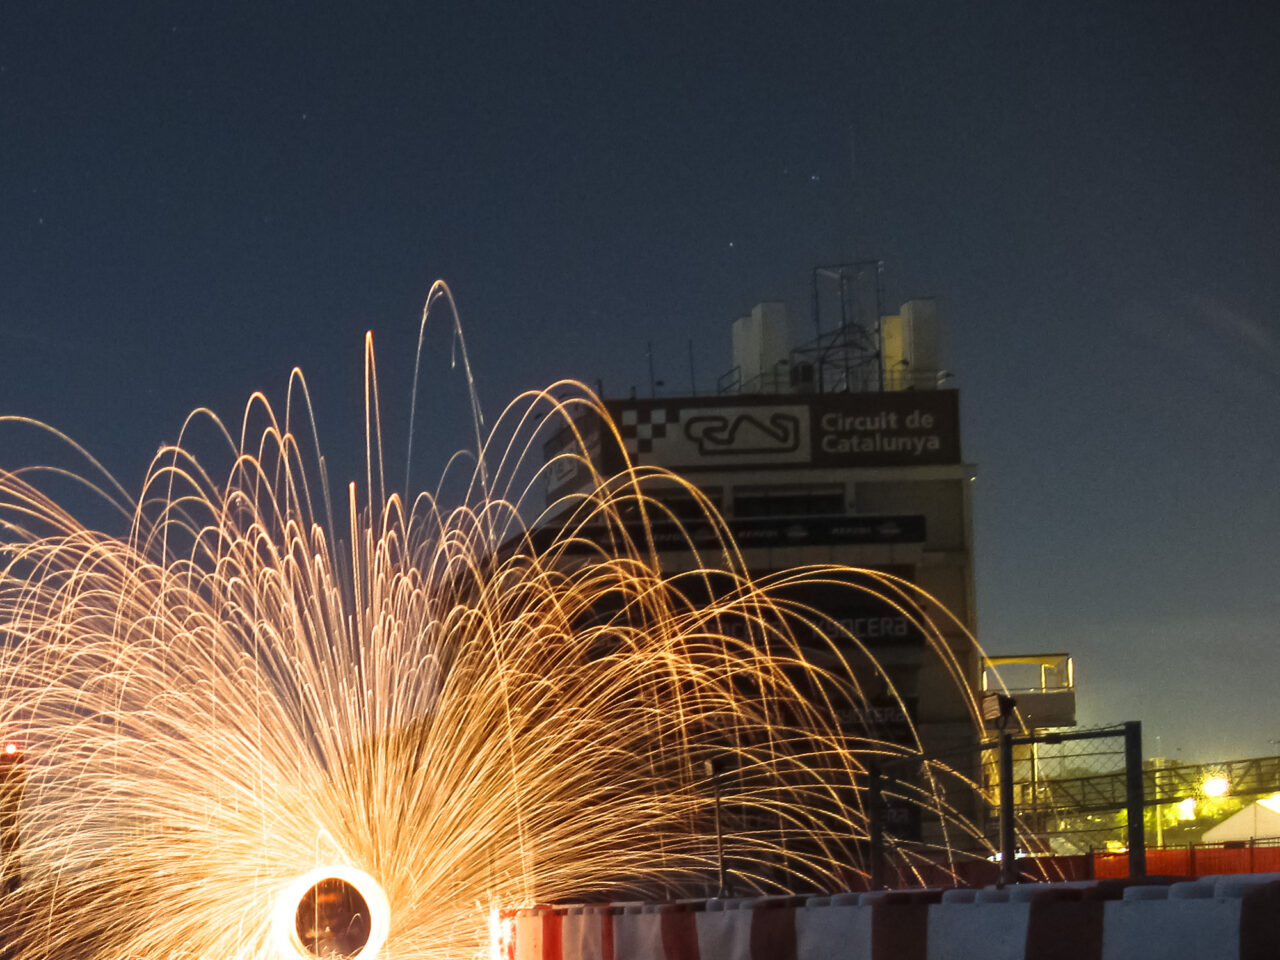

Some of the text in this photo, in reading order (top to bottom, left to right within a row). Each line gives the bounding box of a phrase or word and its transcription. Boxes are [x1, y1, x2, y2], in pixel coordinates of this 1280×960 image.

[821, 409, 935, 431] Circuit de
[821, 433, 941, 456] Catalunya
